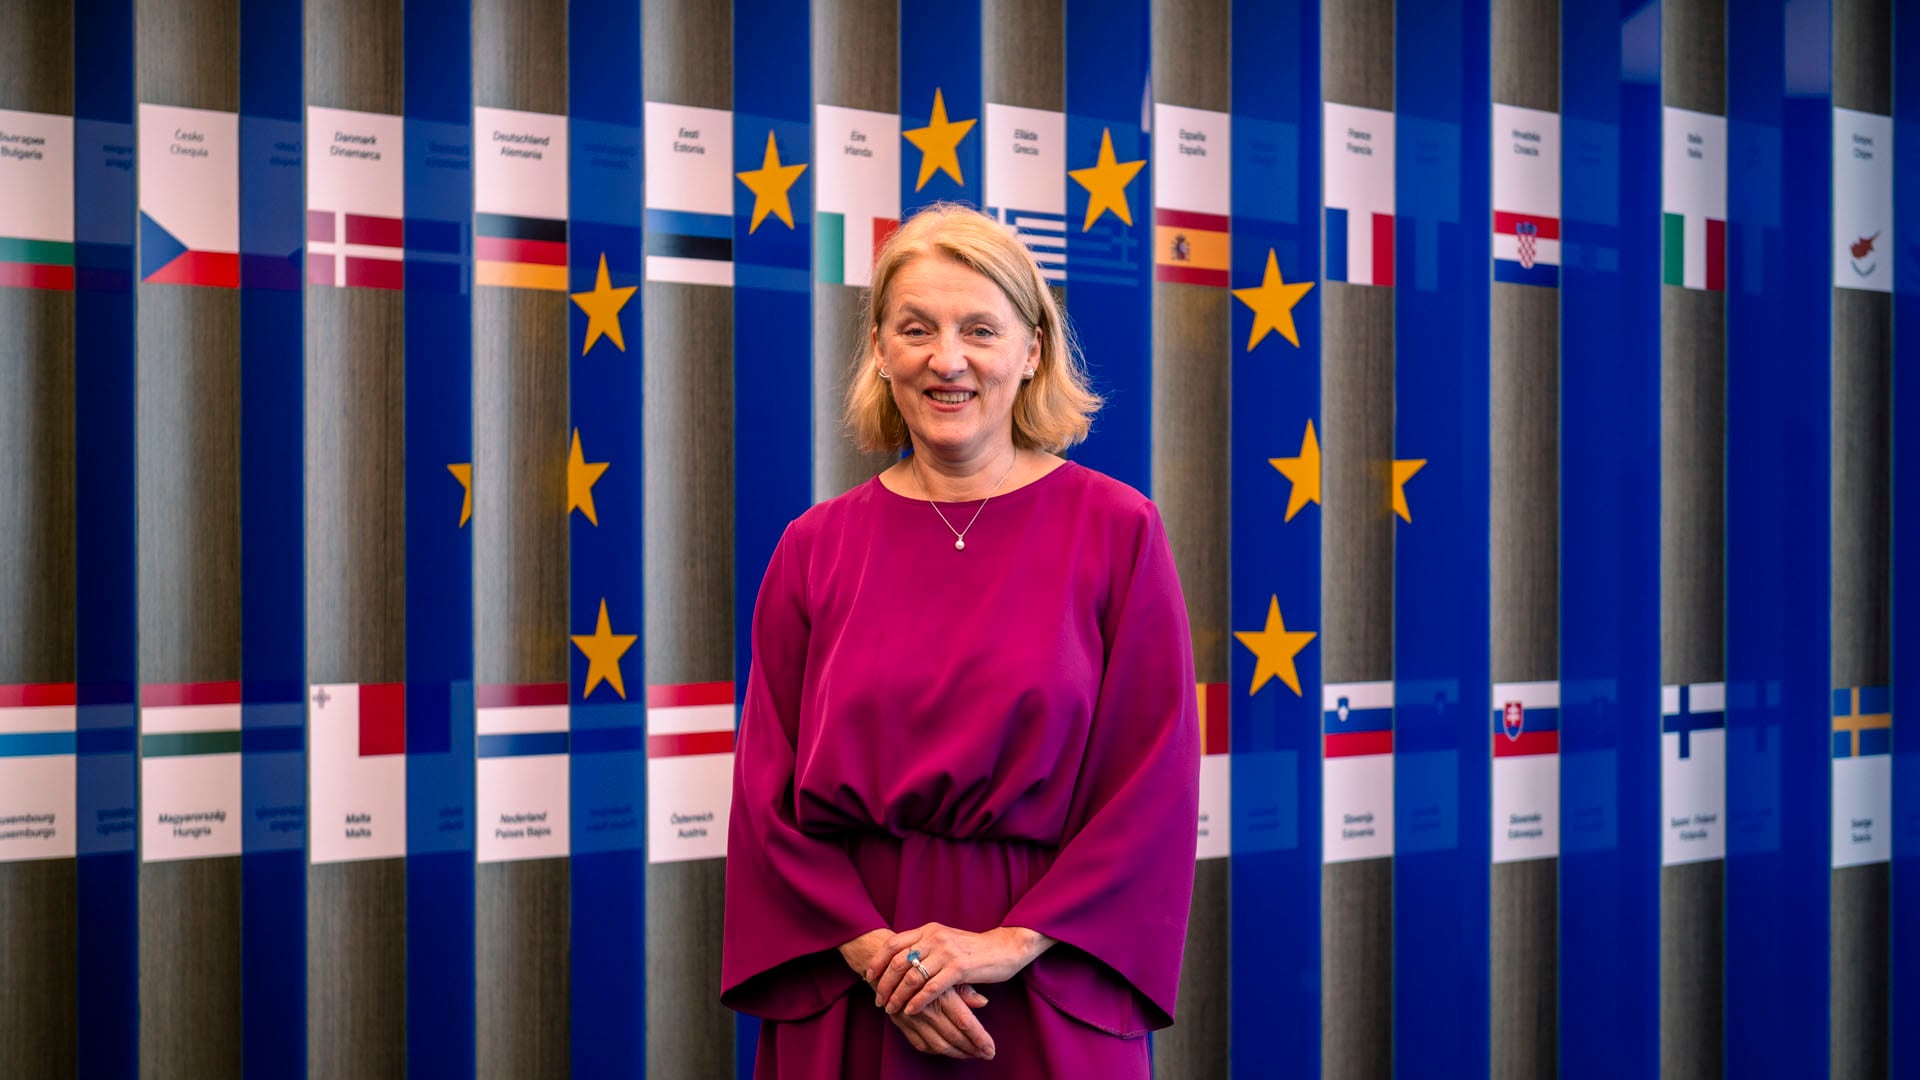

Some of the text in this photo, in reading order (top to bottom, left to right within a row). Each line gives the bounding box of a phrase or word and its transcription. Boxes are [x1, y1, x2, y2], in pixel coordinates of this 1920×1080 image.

[175, 128, 204, 143] Česko
[335, 131, 377, 145] Danmark
[493, 130, 550, 147] Deutschland
[1, 146, 43, 160] Bulgaria
[170, 144, 208, 158] Chequia
[330, 146, 381, 161] Dinamarca
[500, 146, 543, 160] Alemania
[674, 142, 705, 155] Estonia
[844, 145, 873, 158] Irlanda
[1013, 144, 1039, 156] Grecia
[1179, 144, 1206, 157] España
[1346, 142, 1373, 156] Francia
[346, 812, 371, 824] Malta
[500, 811, 547, 824] Nederland
[671, 812, 714, 824] Österreich
[346, 827, 371, 839] Malta
[526, 826, 551, 839] Bajos
[678, 827, 707, 839] Austria
